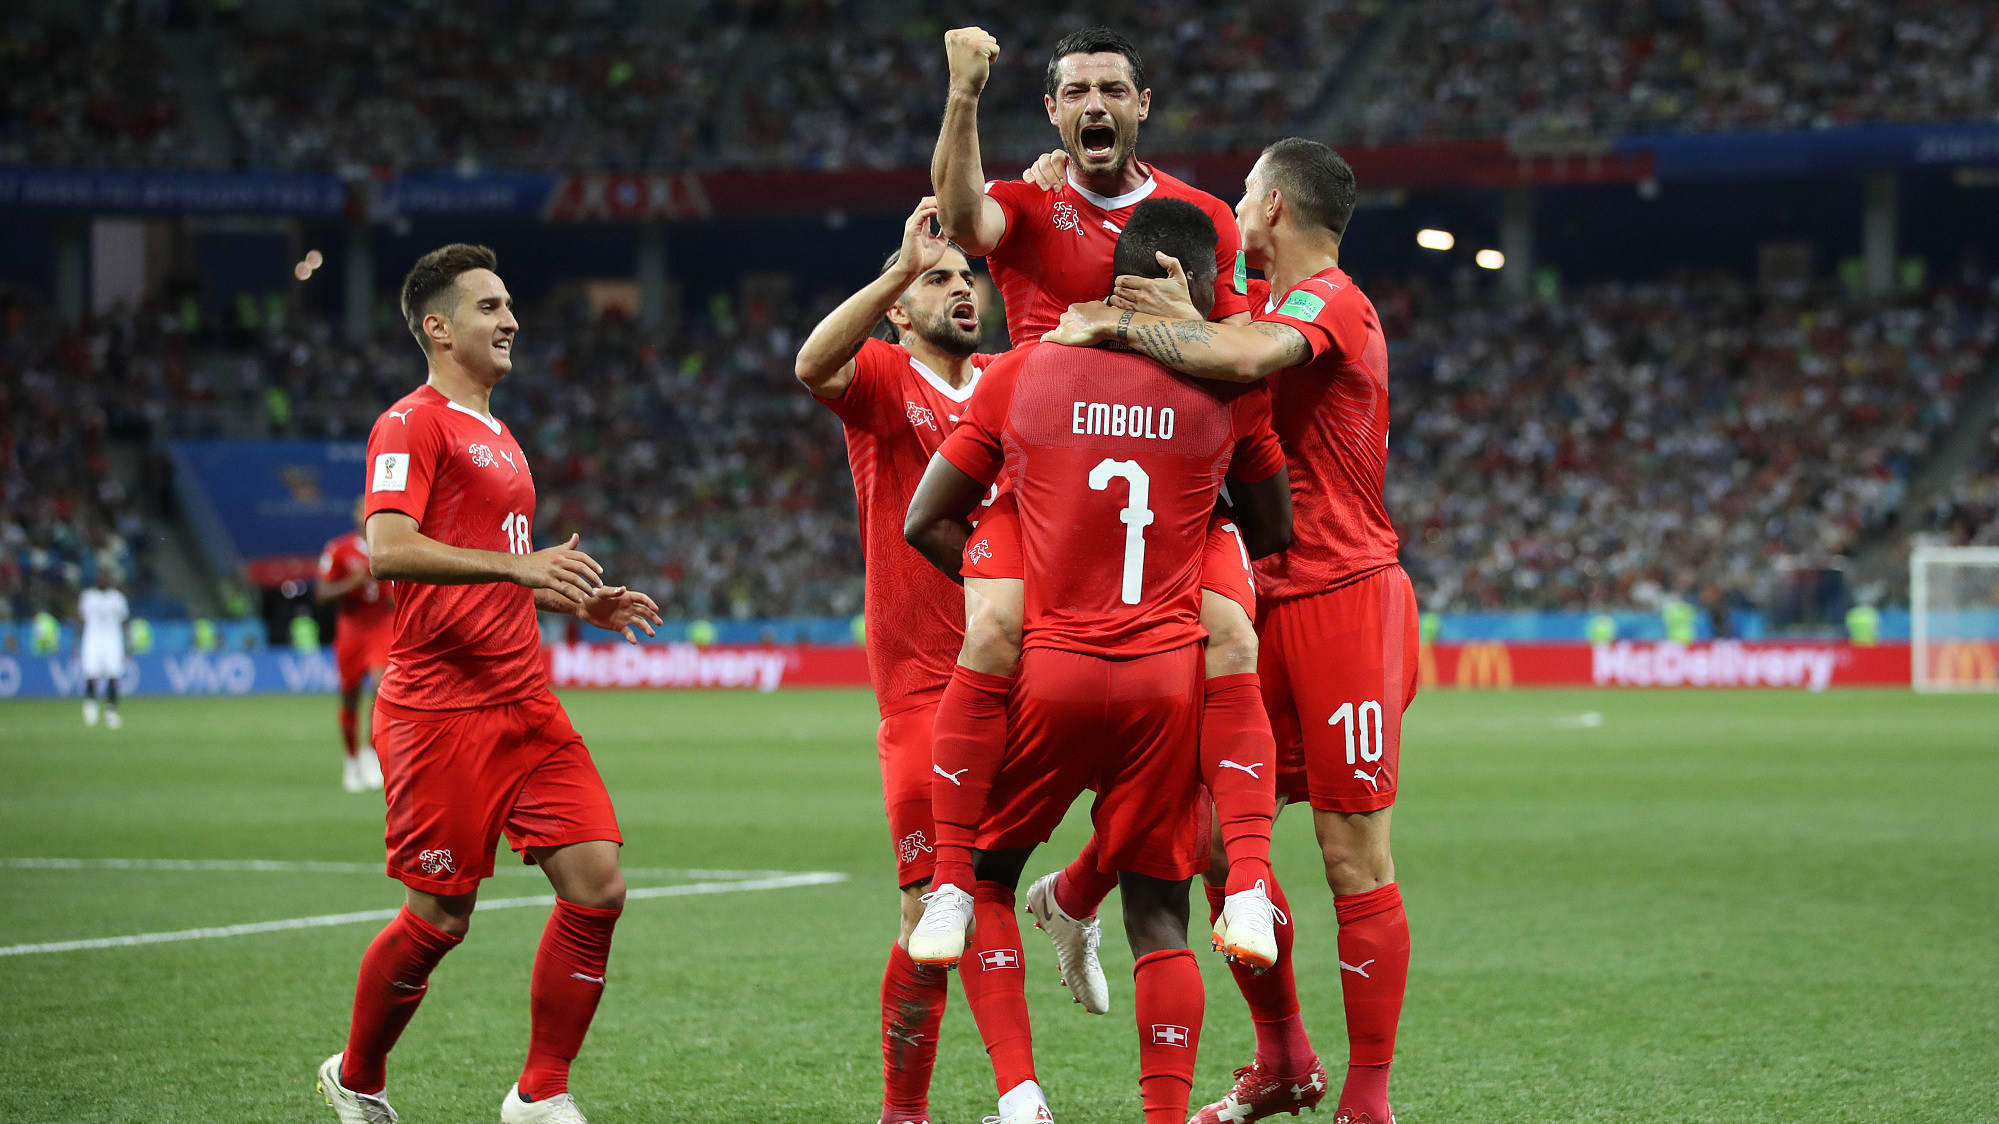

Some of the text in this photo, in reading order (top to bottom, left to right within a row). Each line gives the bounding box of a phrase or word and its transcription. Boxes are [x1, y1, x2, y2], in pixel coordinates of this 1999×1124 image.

[1072, 401, 1175, 440] EMBOLO
[501, 511, 531, 555] 18
[1088, 458, 1154, 605] 7
[552, 642, 787, 693] McDelivery
[1593, 641, 1834, 693] McDelivery
[1328, 700, 1383, 765] 10
